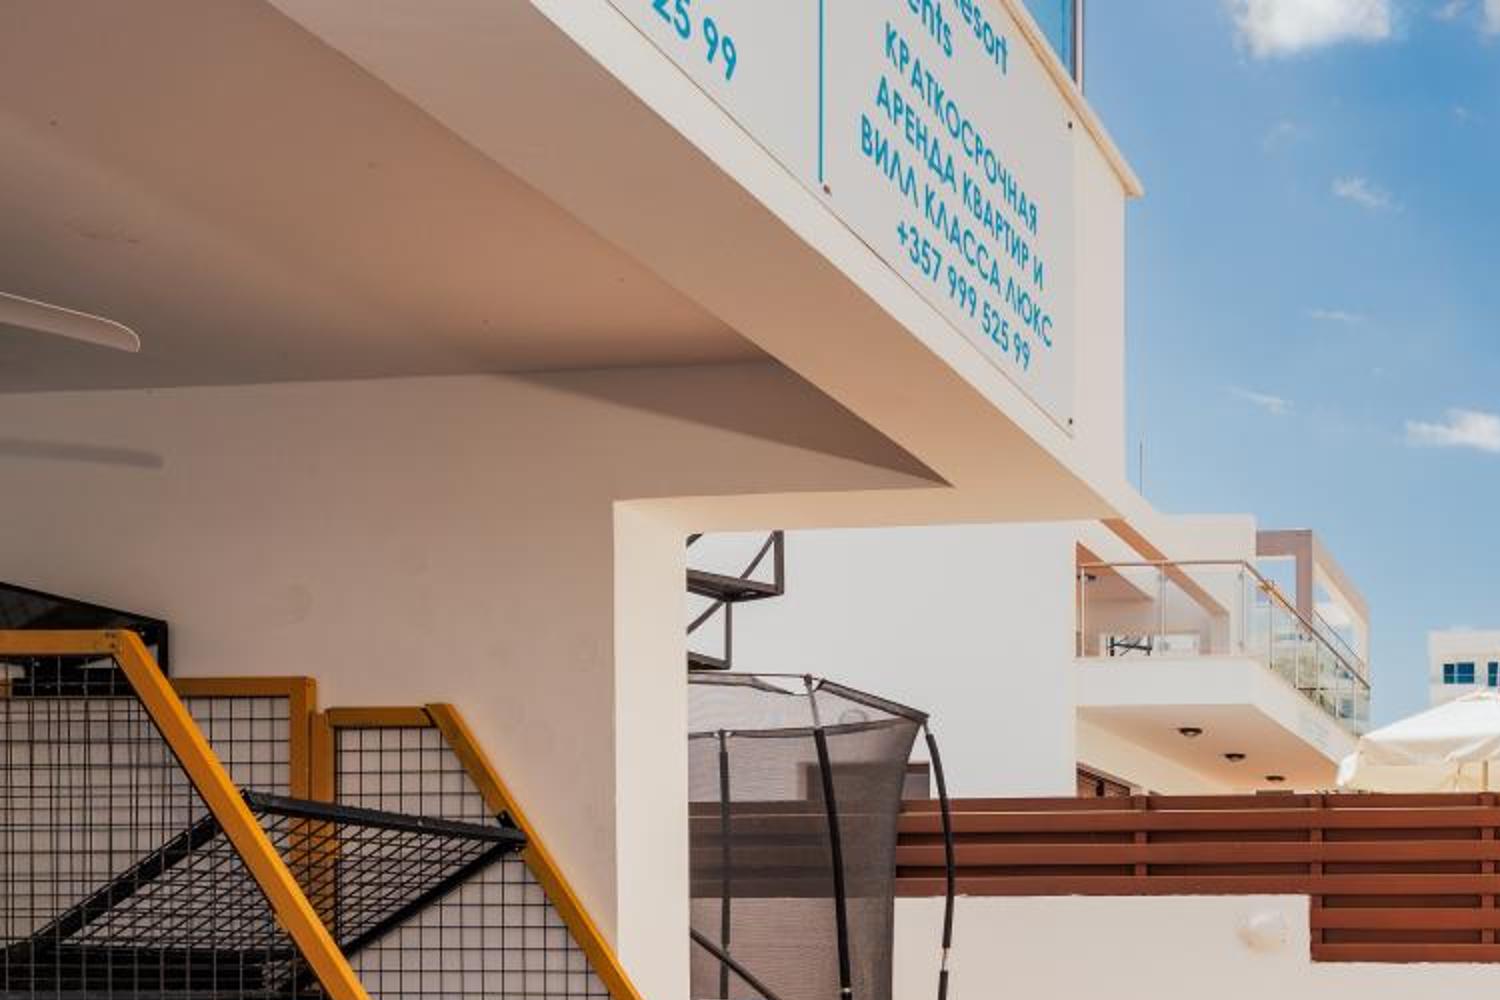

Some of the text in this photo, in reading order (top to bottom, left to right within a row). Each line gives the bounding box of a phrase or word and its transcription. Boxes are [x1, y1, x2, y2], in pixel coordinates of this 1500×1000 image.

[703, 16, 736, 81] 99
[884, 20, 1038, 236] КРАТКОСРОЧНАЯ
[954, 0, 1007, 76] esort
[861, 113, 1053, 348] ВИЛЛ КЛАССА ЛЮКС
[876, 74, 1044, 291] АРЕНДА КВАРТИР И
[896, 220, 1032, 371] +357 999 525 99
